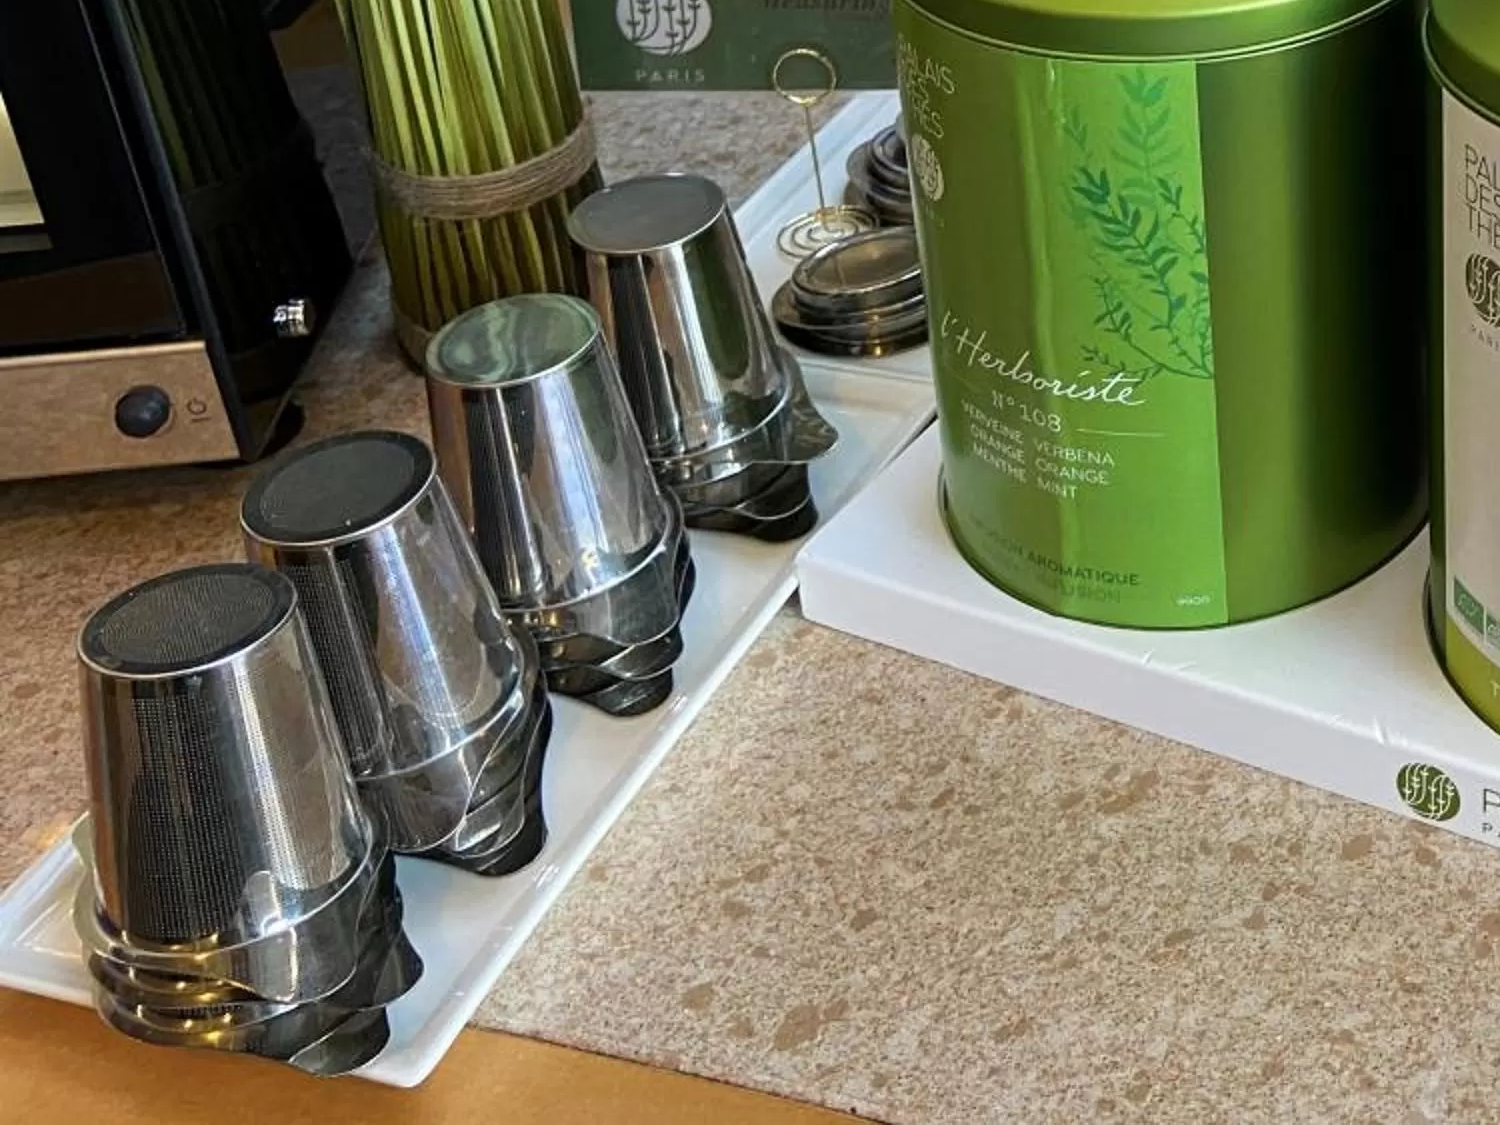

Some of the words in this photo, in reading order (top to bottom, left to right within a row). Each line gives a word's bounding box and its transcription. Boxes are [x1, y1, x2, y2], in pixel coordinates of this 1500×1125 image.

[635, 69, 705, 83] PARIS
[1019, 403, 1062, 433] 108
[969, 424, 1026, 464] ORANGE
[1035, 457, 1110, 485] ORANGE
[1032, 436, 1115, 467] VERBENA
[1036, 476, 1078, 499] MINT
[1027, 551, 1140, 586] AROMATIQUE
